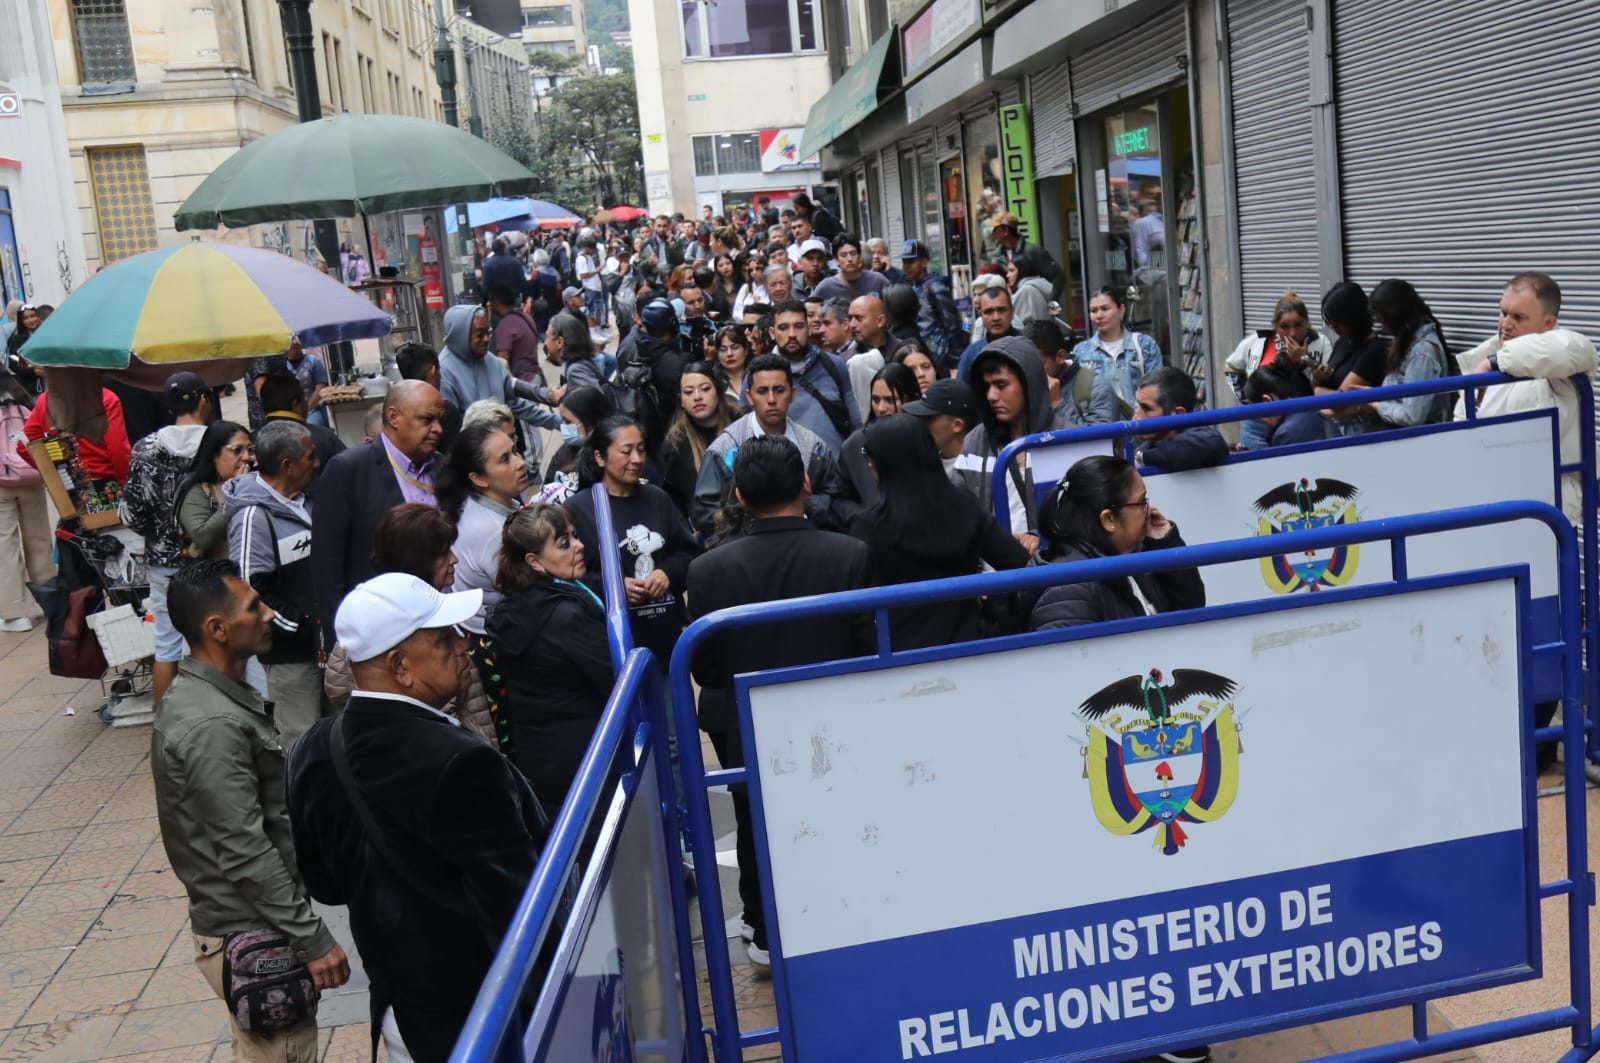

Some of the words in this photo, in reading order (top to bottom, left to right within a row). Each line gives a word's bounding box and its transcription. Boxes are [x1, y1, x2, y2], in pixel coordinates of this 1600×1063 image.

[1119, 719, 1151, 734] LIBERTAD
[1180, 712, 1202, 721] ORDEN
[1013, 897, 1266, 979] MINISTERIO
[1280, 883, 1333, 932] DE
[258, 958, 289, 972] CAMELBAK
[898, 972, 1175, 1060] RELACIONES
[1188, 921, 1443, 1006] EXTERIORES
